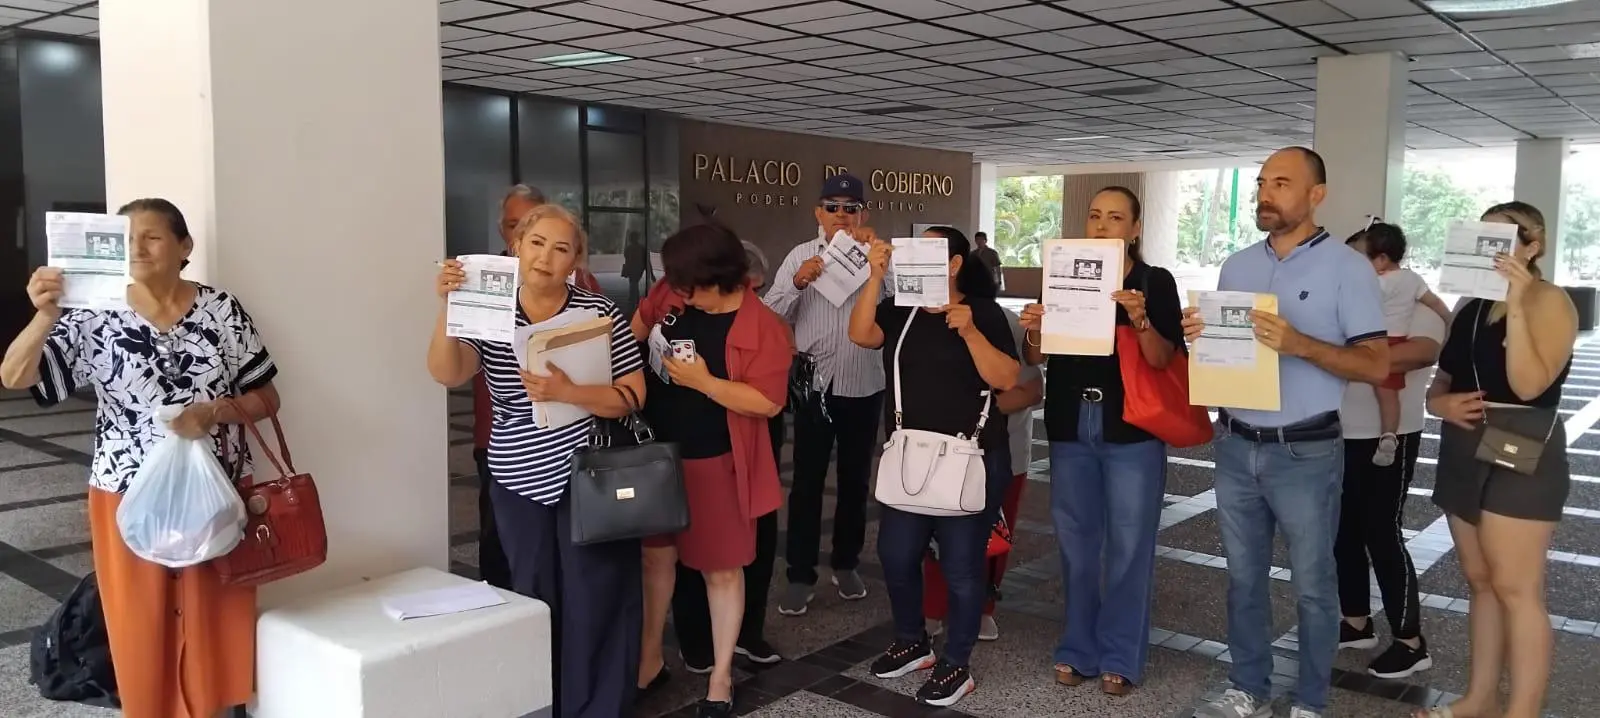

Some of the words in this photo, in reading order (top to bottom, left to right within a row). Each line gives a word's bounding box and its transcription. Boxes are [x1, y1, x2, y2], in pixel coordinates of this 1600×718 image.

[695, 153, 801, 186] PALACIO
[871, 169, 954, 197] GOBIERNO
[736, 192, 799, 206] PODER
[866, 200, 925, 213] CUTIVO
